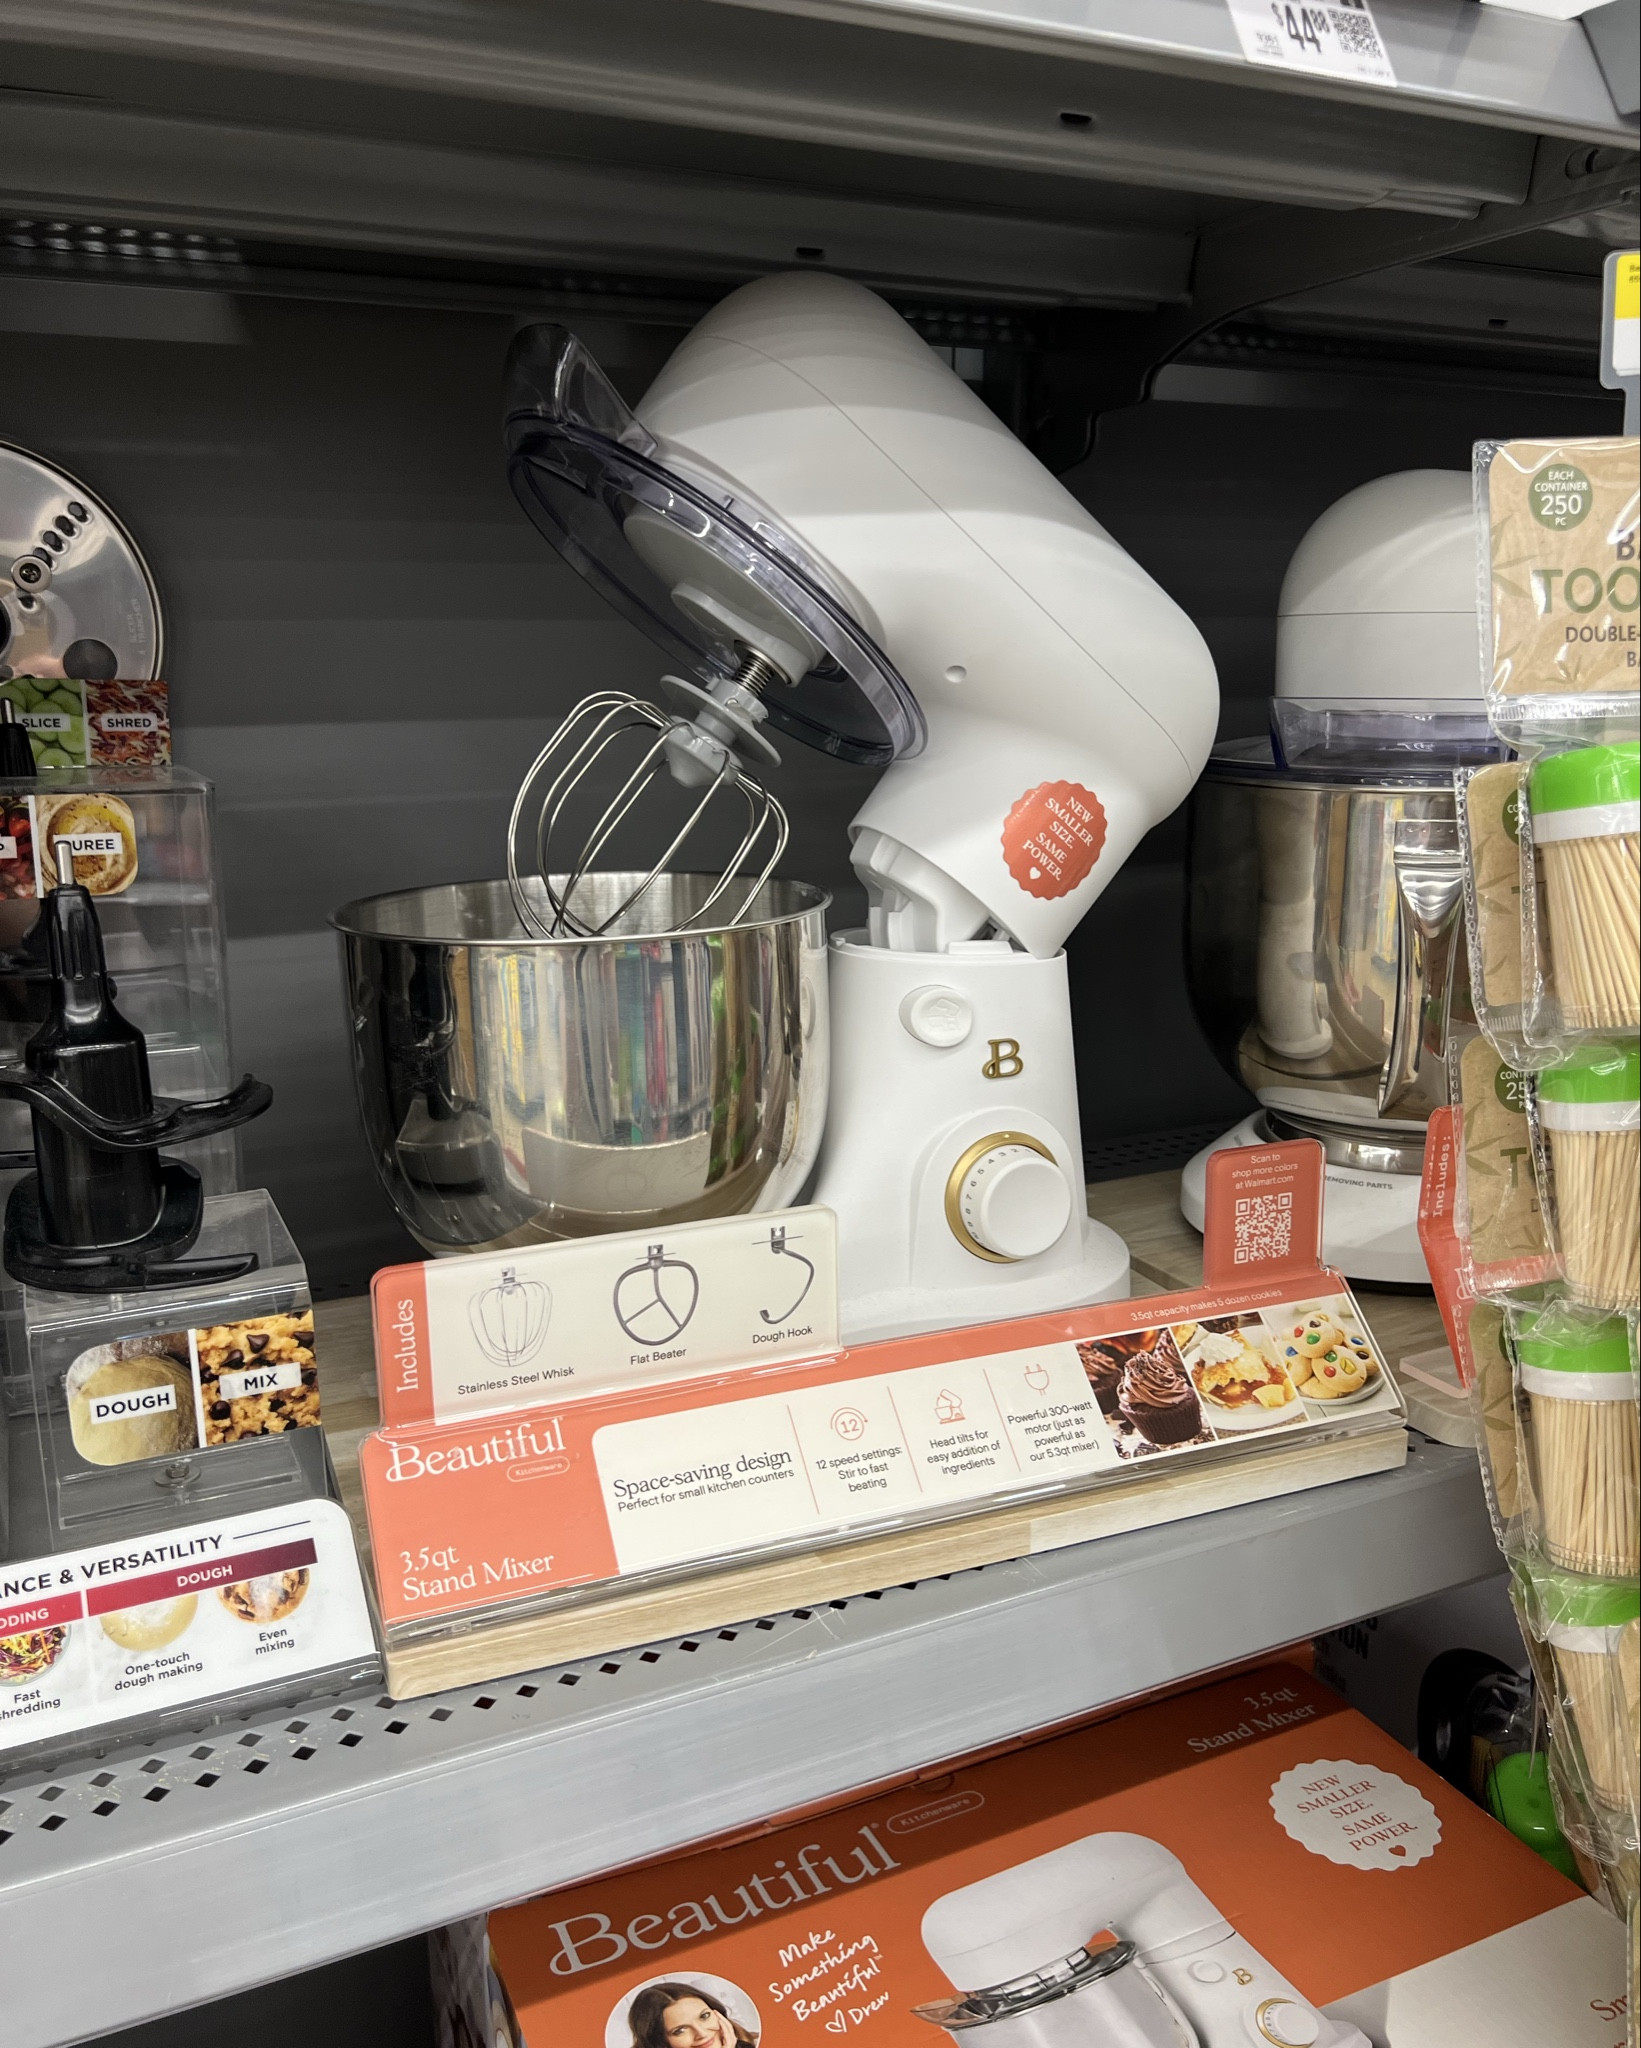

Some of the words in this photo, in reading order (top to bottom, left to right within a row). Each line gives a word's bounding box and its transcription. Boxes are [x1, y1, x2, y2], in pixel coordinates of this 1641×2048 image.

[1534, 481, 1589, 493] CONTAINER
[1548, 471, 1574, 481] EACH
[1540, 495, 1582, 516] 250
[1555, 517, 1567, 526] PC
[22, 718, 61, 729] SLICE
[106, 717, 152, 729] SHRED
[1066, 796, 1094, 823] NEW
[1044, 797, 1094, 847] SMALLER
[72, 839, 115, 852] UREE
[1035, 832, 1068, 864] SAME
[1250, 1154, 1271, 1165] Scan
[1271, 1152, 1281, 1162] to
[1231, 1168, 1252, 1180] shop
[1252, 1166, 1274, 1177] more
[1274, 1162, 1299, 1174] colors
[1235, 1180, 1244, 1190] at
[1244, 1174, 1294, 1188] Walmart.com
[1432, 1135, 1452, 1218] Includes:
[1366, 1182, 1393, 1190] PARTS
[1154, 1302, 1189, 1319] capacity
[1190, 1299, 1216, 1312] makes
[1224, 1293, 1251, 1306] dozen
[1251, 1288, 1283, 1302] cookies
[392, 1298, 420, 1393] Includes
[752, 1329, 785, 1345] Dough
[786, 1325, 813, 1339] Hook
[629, 1353, 650, 1366] Flat
[651, 1347, 687, 1363] Beater
[243, 1373, 279, 1391] MIX
[457, 1376, 509, 1395] Stainless
[510, 1372, 539, 1387] Steel
[541, 1366, 575, 1383] Whisk
[95, 1393, 171, 1419] DOUGH
[1007, 1407, 1049, 1425] Powerful
[1048, 1400, 1093, 1416] 300-watt
[840, 1418, 860, 1434] 12
[1023, 1422, 1052, 1436] motor
[1053, 1418, 1074, 1433] (just
[1074, 1416, 1086, 1425] as
[385, 1416, 567, 1482] Beautiful
[928, 1437, 956, 1449] Head
[956, 1433, 974, 1445] tilts
[974, 1429, 989, 1441] for
[1029, 1452, 1046, 1462] our
[1046, 1445, 1071, 1460] 5.3qt
[1071, 1440, 1100, 1455] mixer)
[1033, 1431, 1073, 1449] powerful
[1074, 1429, 1086, 1439] as
[815, 1460, 827, 1470] 12
[828, 1453, 861, 1469] speed
[861, 1446, 903, 1463] settings:
[926, 1452, 950, 1466] easy
[950, 1444, 989, 1460] addition
[990, 1440, 1002, 1451] of
[613, 1463, 733, 1499] Space-saving
[735, 1451, 793, 1474] design
[837, 1467, 857, 1480] Stir
[857, 1466, 869, 1476] to
[869, 1462, 889, 1474] fast
[941, 1457, 996, 1476] ingredients
[617, 1496, 659, 1512] Perfect
[660, 1492, 676, 1504] for
[678, 1486, 706, 1500] small
[708, 1478, 747, 1493] kitchen
[748, 1468, 795, 1486] counters
[848, 1477, 888, 1493] beating
[0, 1573, 52, 1599] NCE
[59, 1568, 74, 1585] &
[80, 1534, 222, 1579] VERSATILITY
[400, 1546, 460, 1574] 3.5qt
[176, 1564, 233, 1587] DOUGH
[402, 1565, 477, 1602] Stand
[482, 1554, 555, 1585] Mixer
[255, 1638, 296, 1656] mixing
[258, 1628, 288, 1642] Even
[124, 1652, 190, 1676] One-touch
[114, 1674, 155, 1691] dough
[158, 1662, 204, 1681] making
[13, 1689, 41, 1704] Fast
[1243, 1686, 1298, 1711] 3.5qt
[1186, 1724, 1255, 1754] Stand
[1255, 1703, 1316, 1733] Mixer
[1300, 1774, 1342, 1796] NEW
[1296, 1780, 1377, 1815] SMALLER
[1329, 1798, 1374, 1820] SIZE.
[900, 1799, 970, 1826] Kitchenware
[1342, 1811, 1393, 1836] SAME
[1349, 1820, 1419, 1852] POWER.
[549, 1826, 902, 1977] Beautiful
[778, 1930, 836, 1968] Make
[768, 1935, 879, 2003] Something
[792, 1957, 881, 2021] Beautiful
[848, 1992, 890, 2025] Drew
